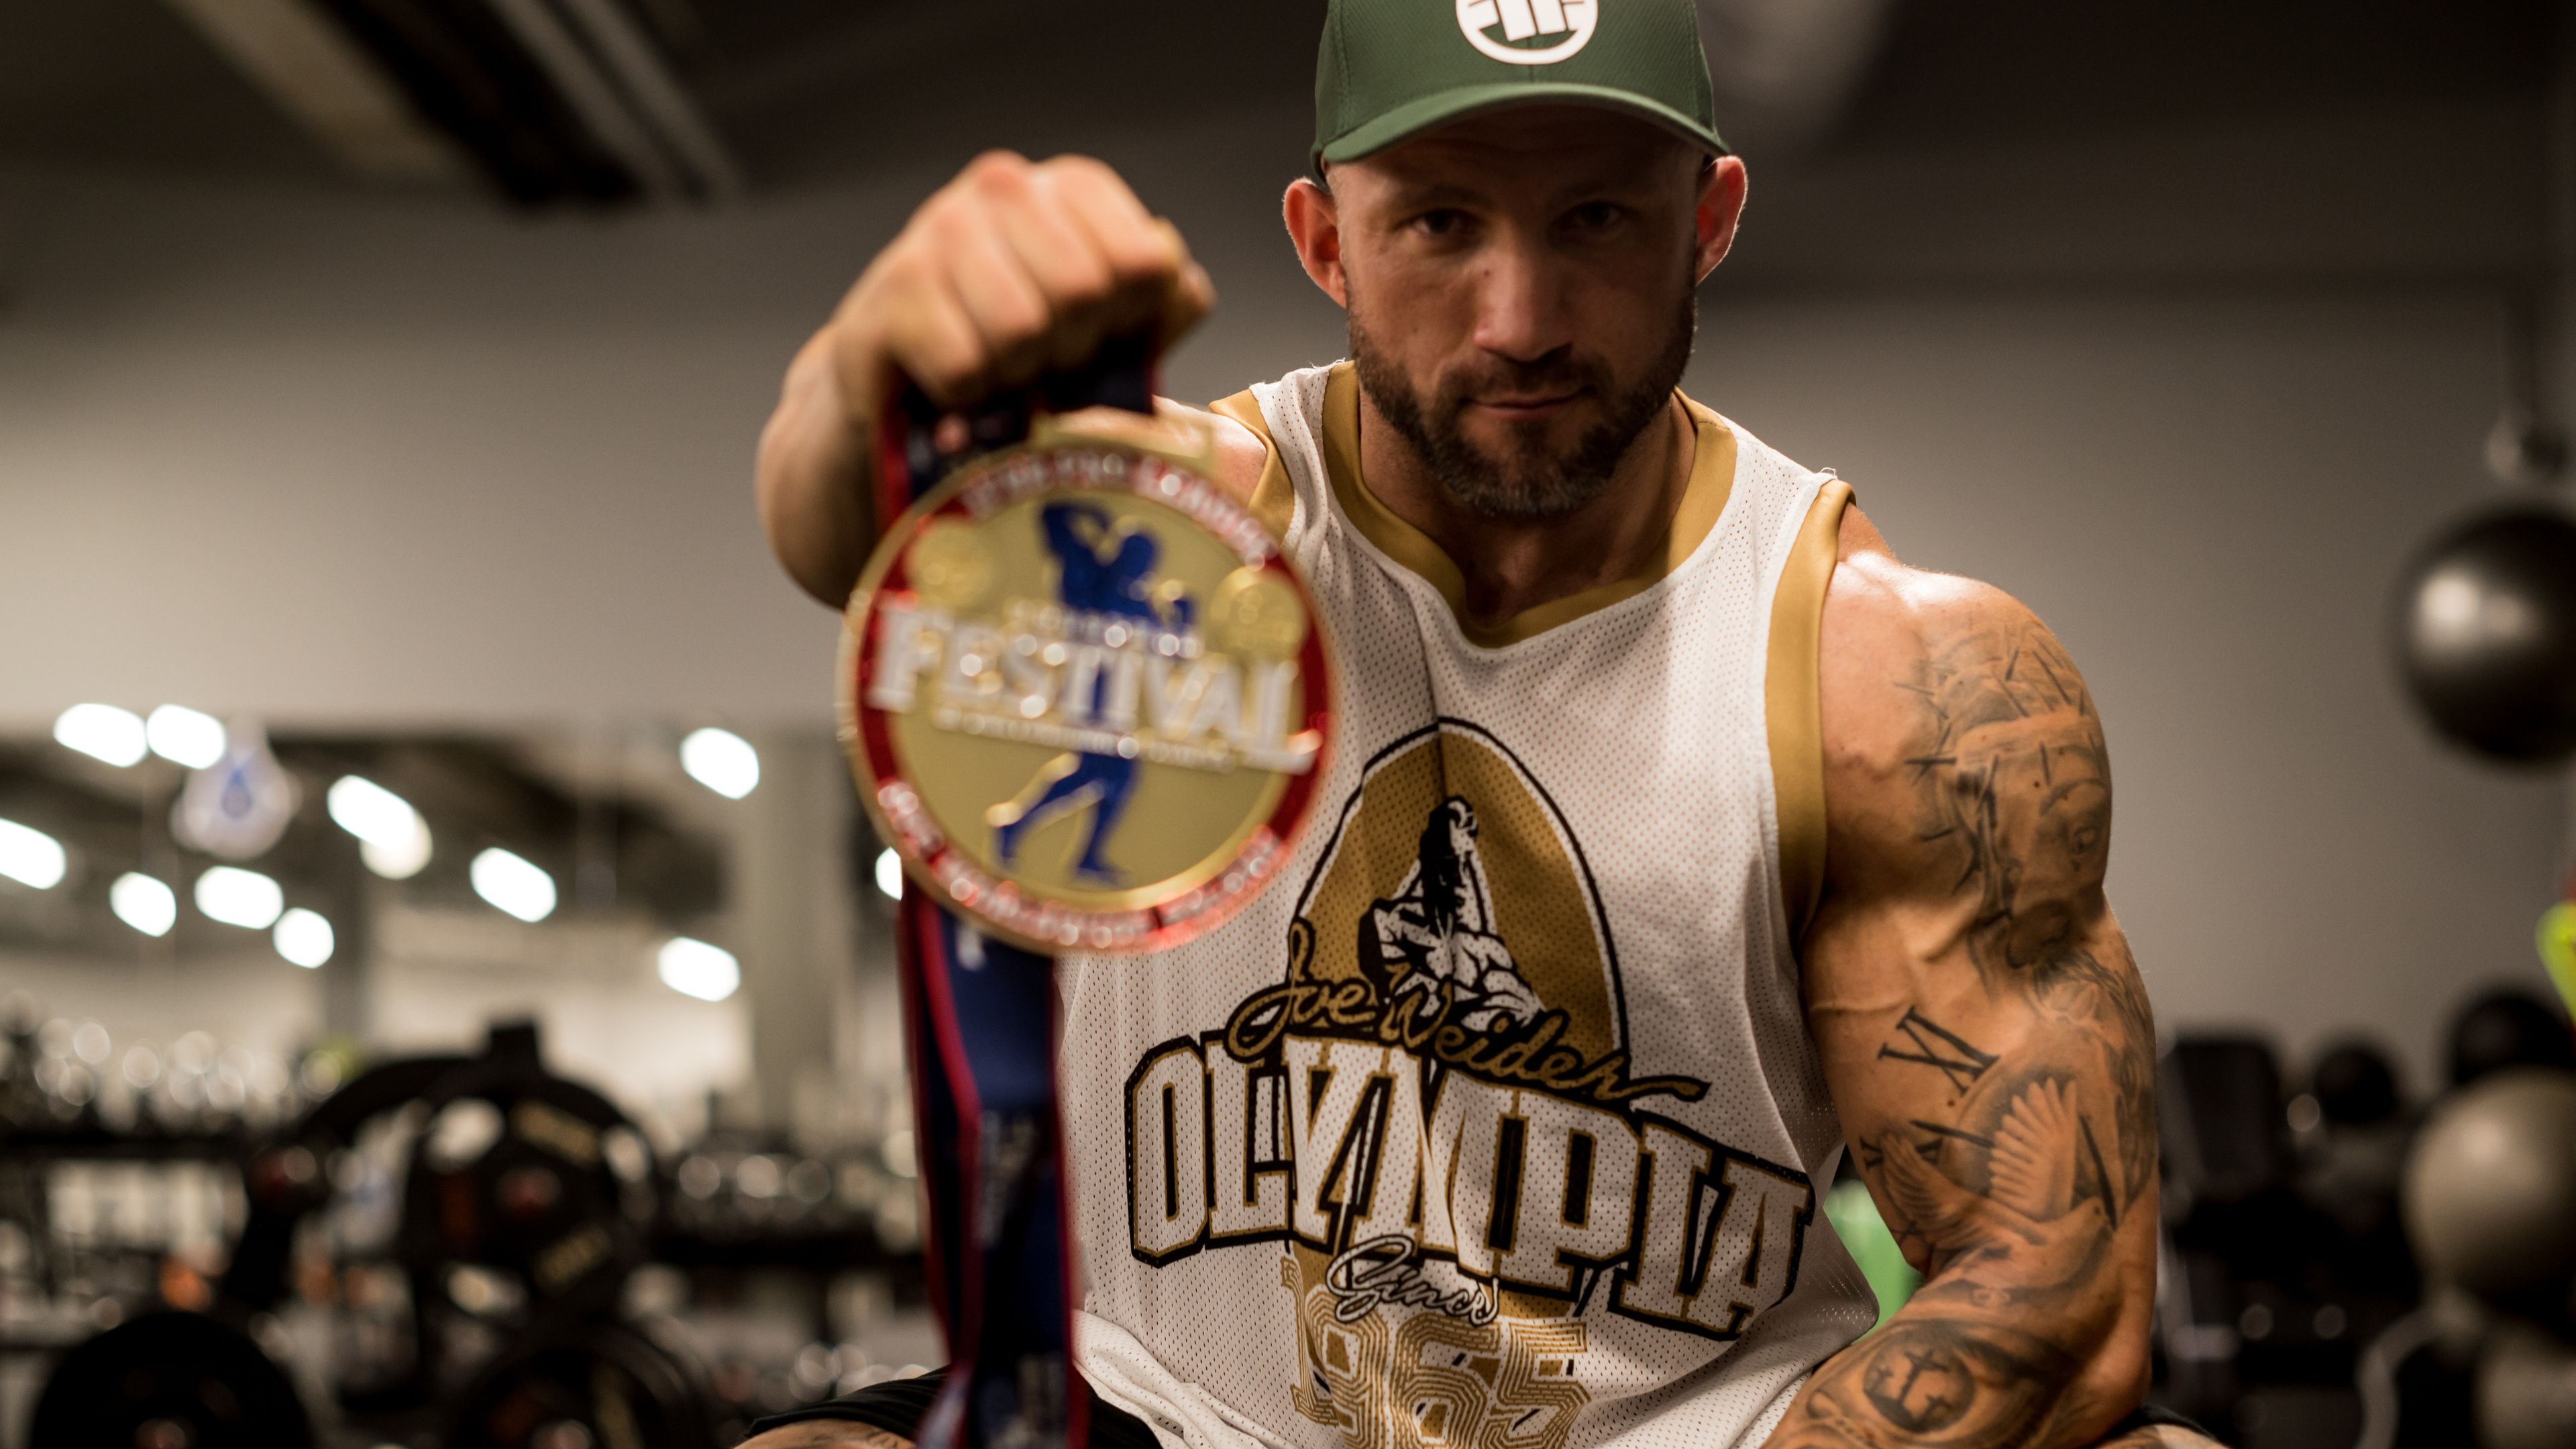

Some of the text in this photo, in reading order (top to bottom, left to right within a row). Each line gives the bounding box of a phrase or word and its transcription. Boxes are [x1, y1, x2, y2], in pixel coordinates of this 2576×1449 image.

[867, 600, 1323, 775] FESTIVAL
[1224, 919, 1706, 1102] Joe Weider
[1127, 1034, 1813, 1339] OLYMPIA
[1280, 1256, 1592, 1449] 1965
[1327, 1234, 1499, 1326] Since
